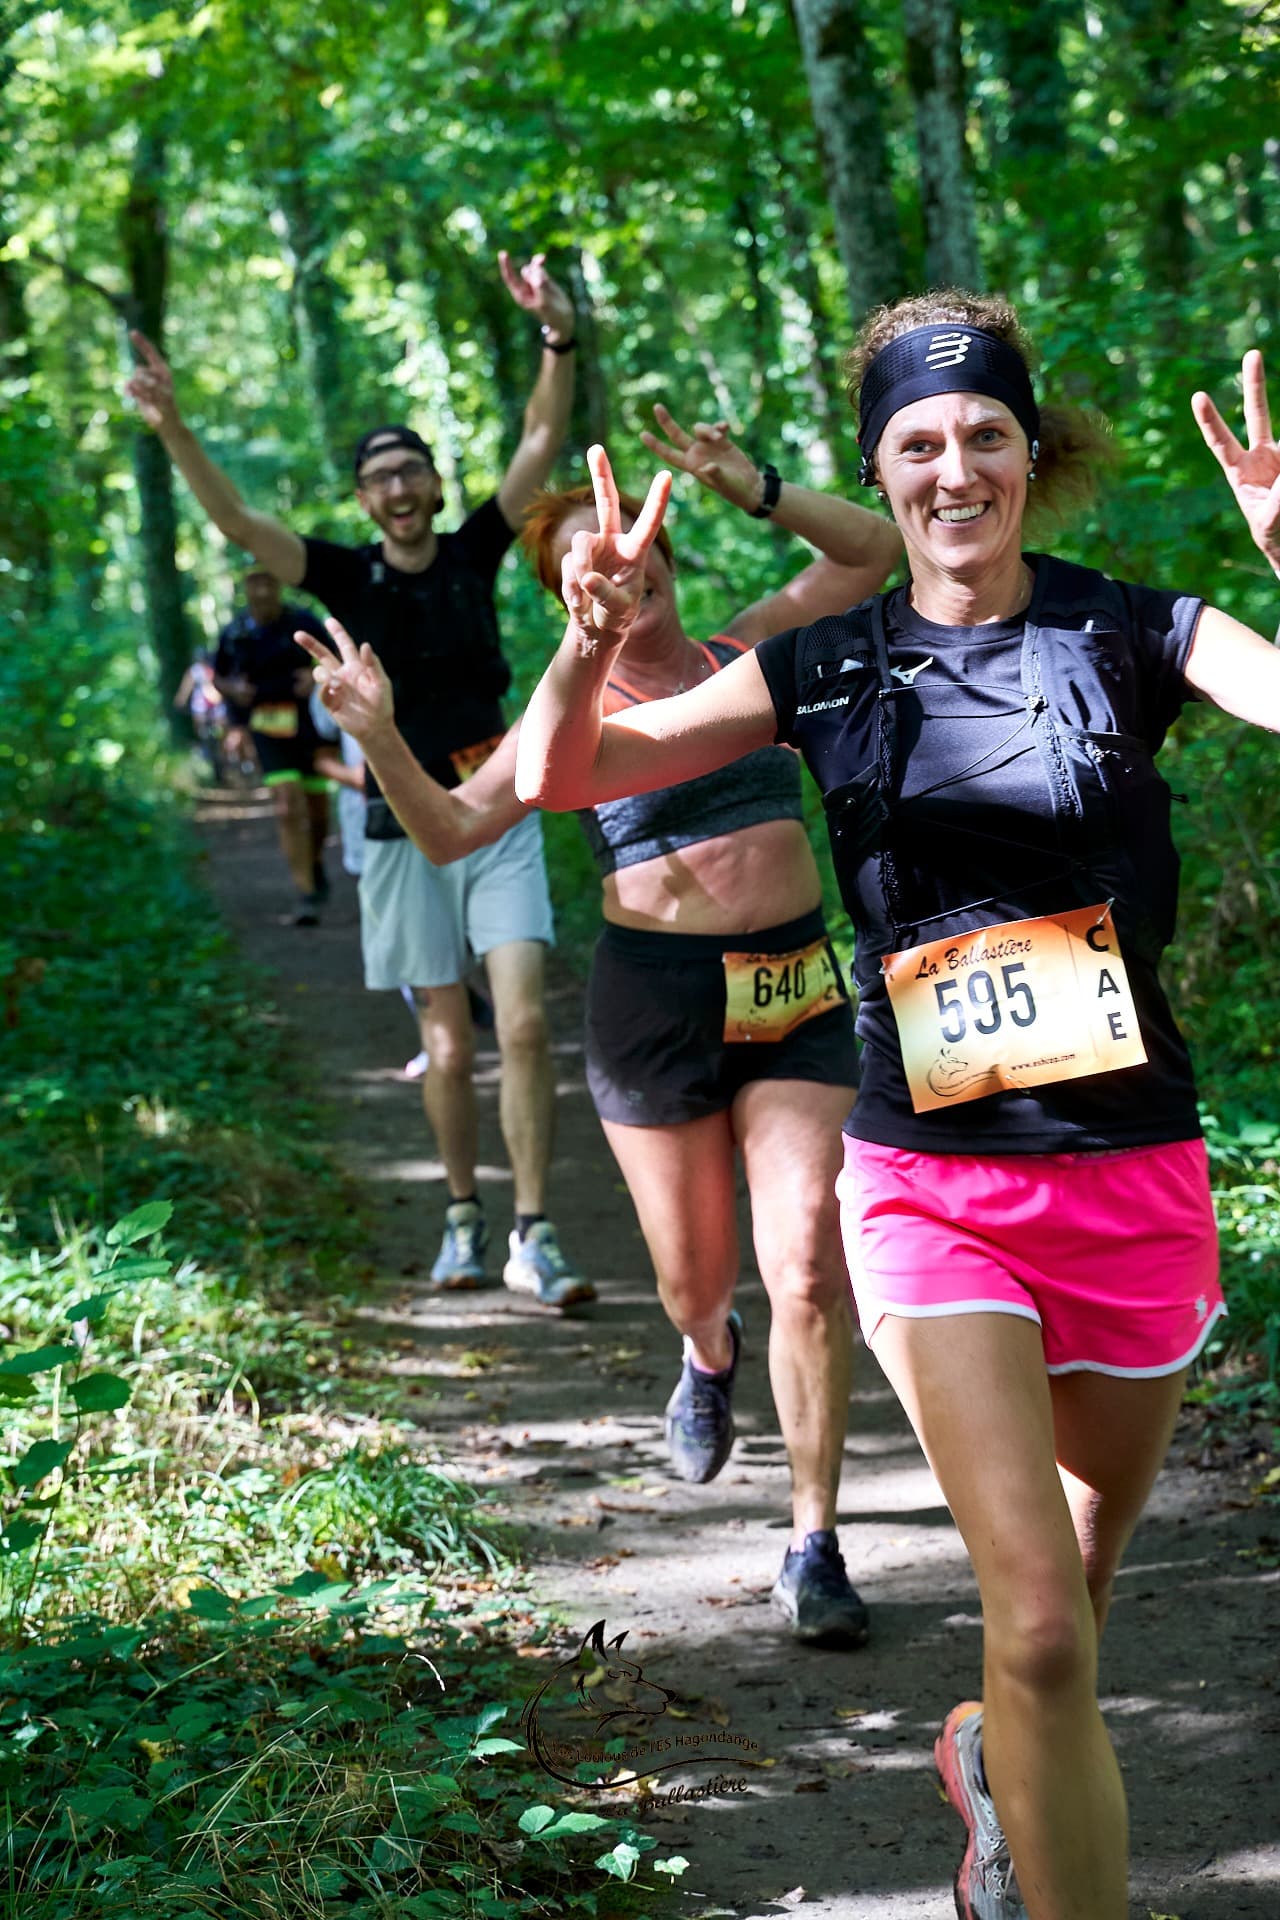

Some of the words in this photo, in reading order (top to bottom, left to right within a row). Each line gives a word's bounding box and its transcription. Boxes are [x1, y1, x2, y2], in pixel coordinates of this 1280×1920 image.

[795, 695, 850, 715] SALOMON
[753, 958, 806, 1007] 640
[915, 956, 939, 980] La
[933, 961, 1037, 1043] 595
